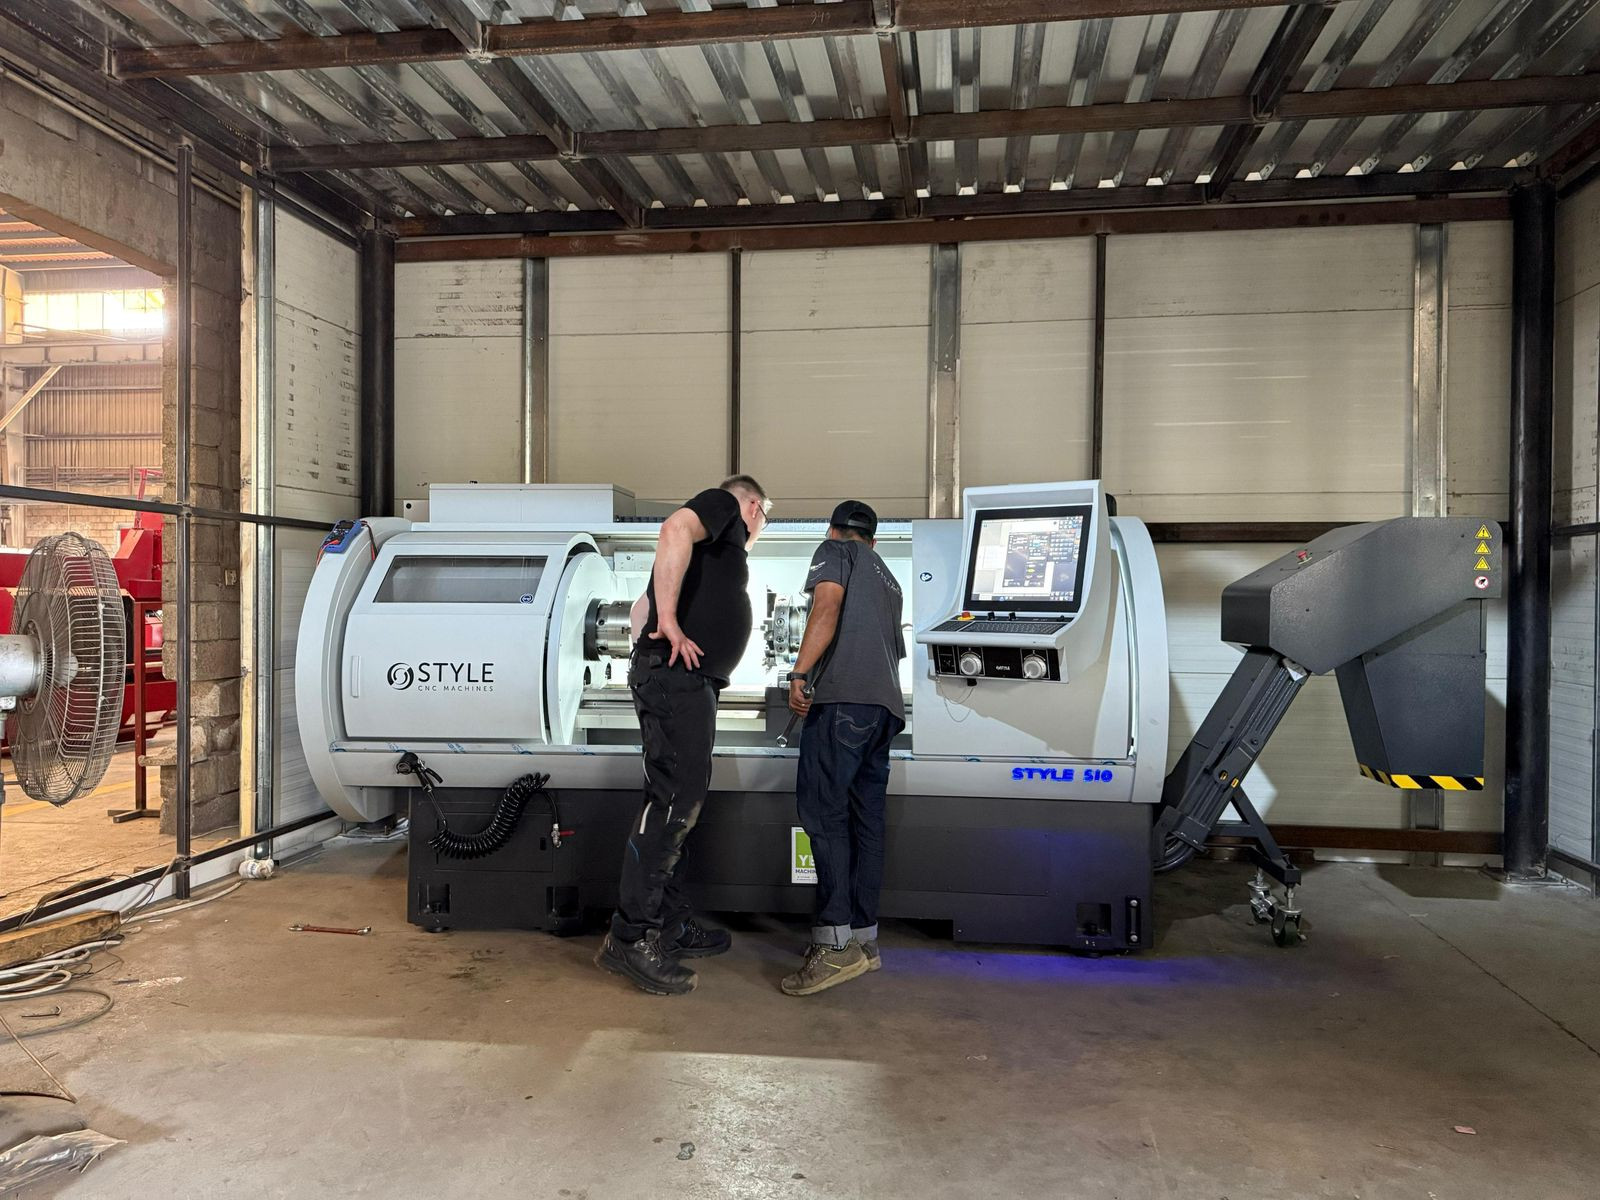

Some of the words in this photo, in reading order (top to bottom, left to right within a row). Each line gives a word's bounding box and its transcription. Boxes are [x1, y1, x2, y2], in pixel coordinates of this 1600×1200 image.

[418, 662, 494, 683] STYLE
[1012, 767, 1075, 782] STYLE
[1083, 768, 1113, 783] S10
